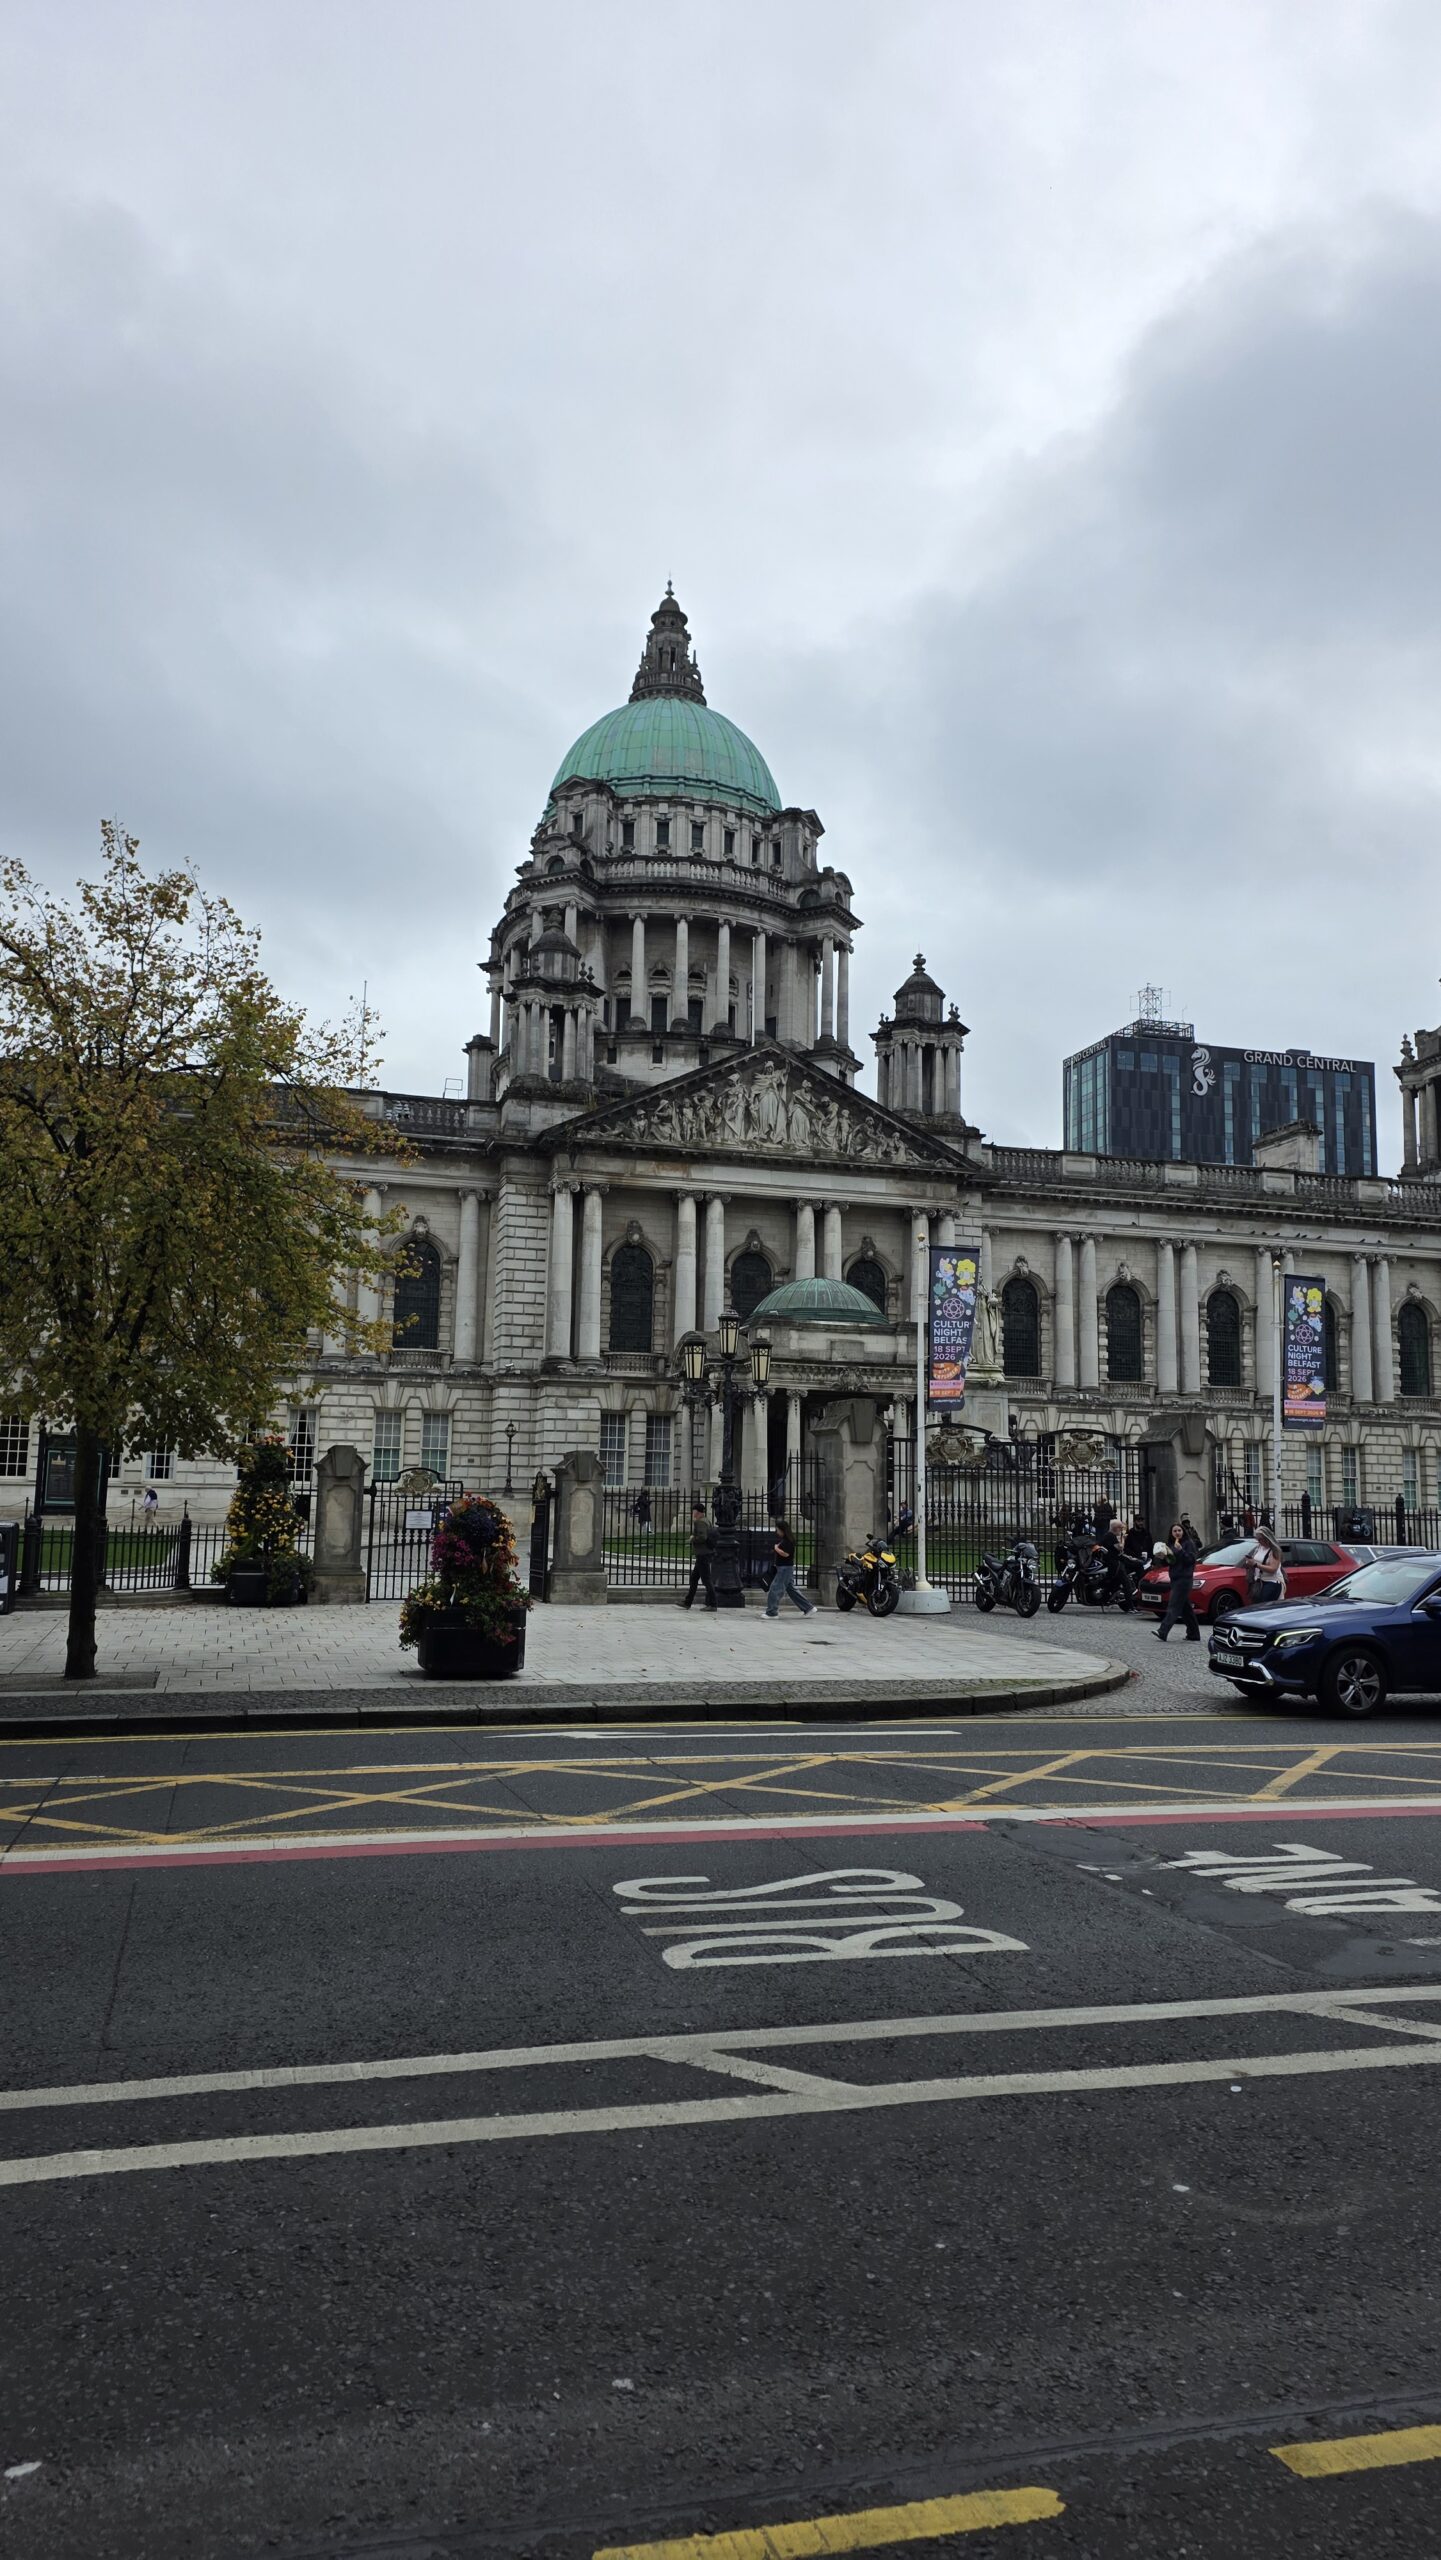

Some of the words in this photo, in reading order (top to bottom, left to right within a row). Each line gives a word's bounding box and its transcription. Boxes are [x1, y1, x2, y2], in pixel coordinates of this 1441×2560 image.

[1244, 1050, 1293, 1066] GRAND
[1297, 1056, 1357, 1073] CENTRAL
[934, 1320, 971, 1329] CULTUR
[934, 1328, 963, 1337] NIGHT
[934, 1336, 968, 1345] BELFAS
[934, 1345, 944, 1353] 18
[1288, 1345, 1323, 1354] CULTURE
[1288, 1352, 1312, 1361] NIGHT
[1288, 1360, 1321, 1369] BELFAST
[1288, 1375, 1307, 1383] 2026
[1164, 1843, 1441, 1925] ANE
[612, 1868, 1032, 1970] BUS
